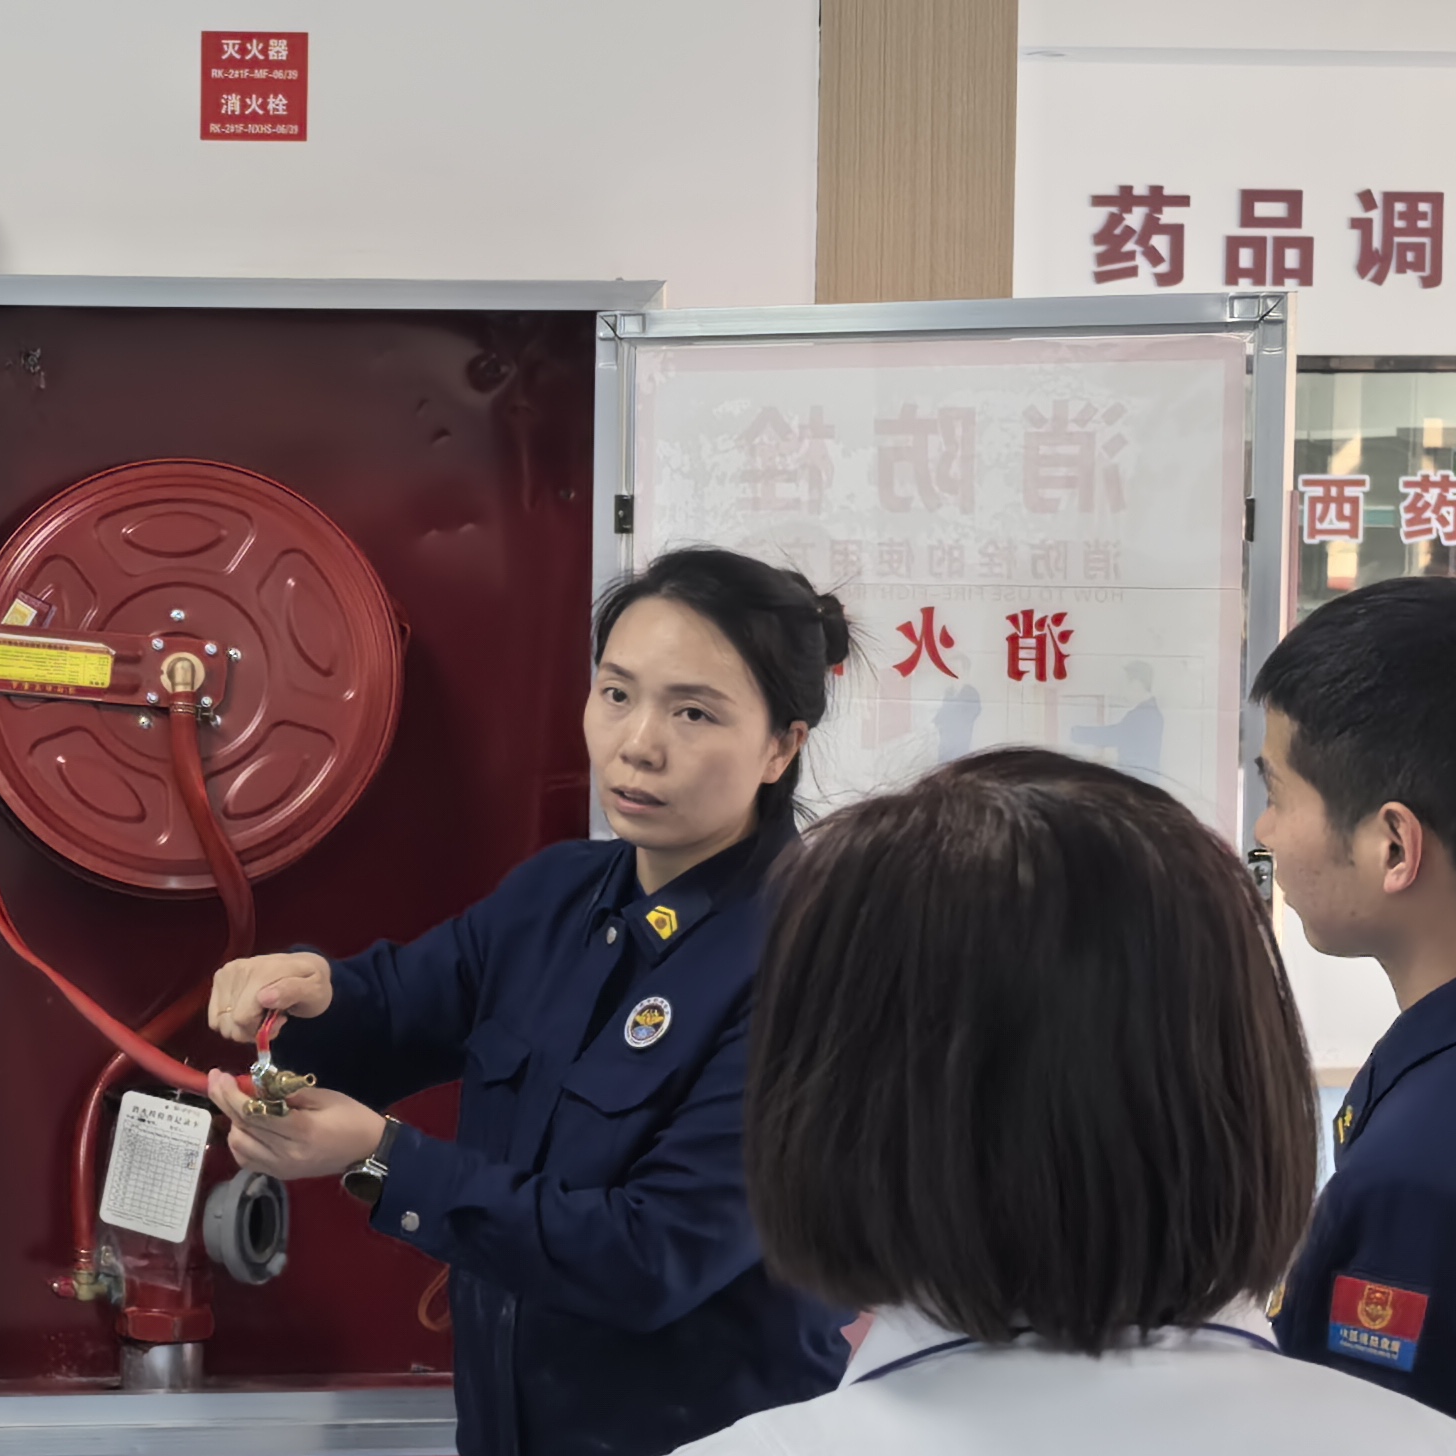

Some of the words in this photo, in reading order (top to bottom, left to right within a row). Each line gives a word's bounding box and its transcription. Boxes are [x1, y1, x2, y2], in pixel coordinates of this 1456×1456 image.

[221, 39, 288, 60] 灭火器
[221, 93, 288, 115] 消火栓
